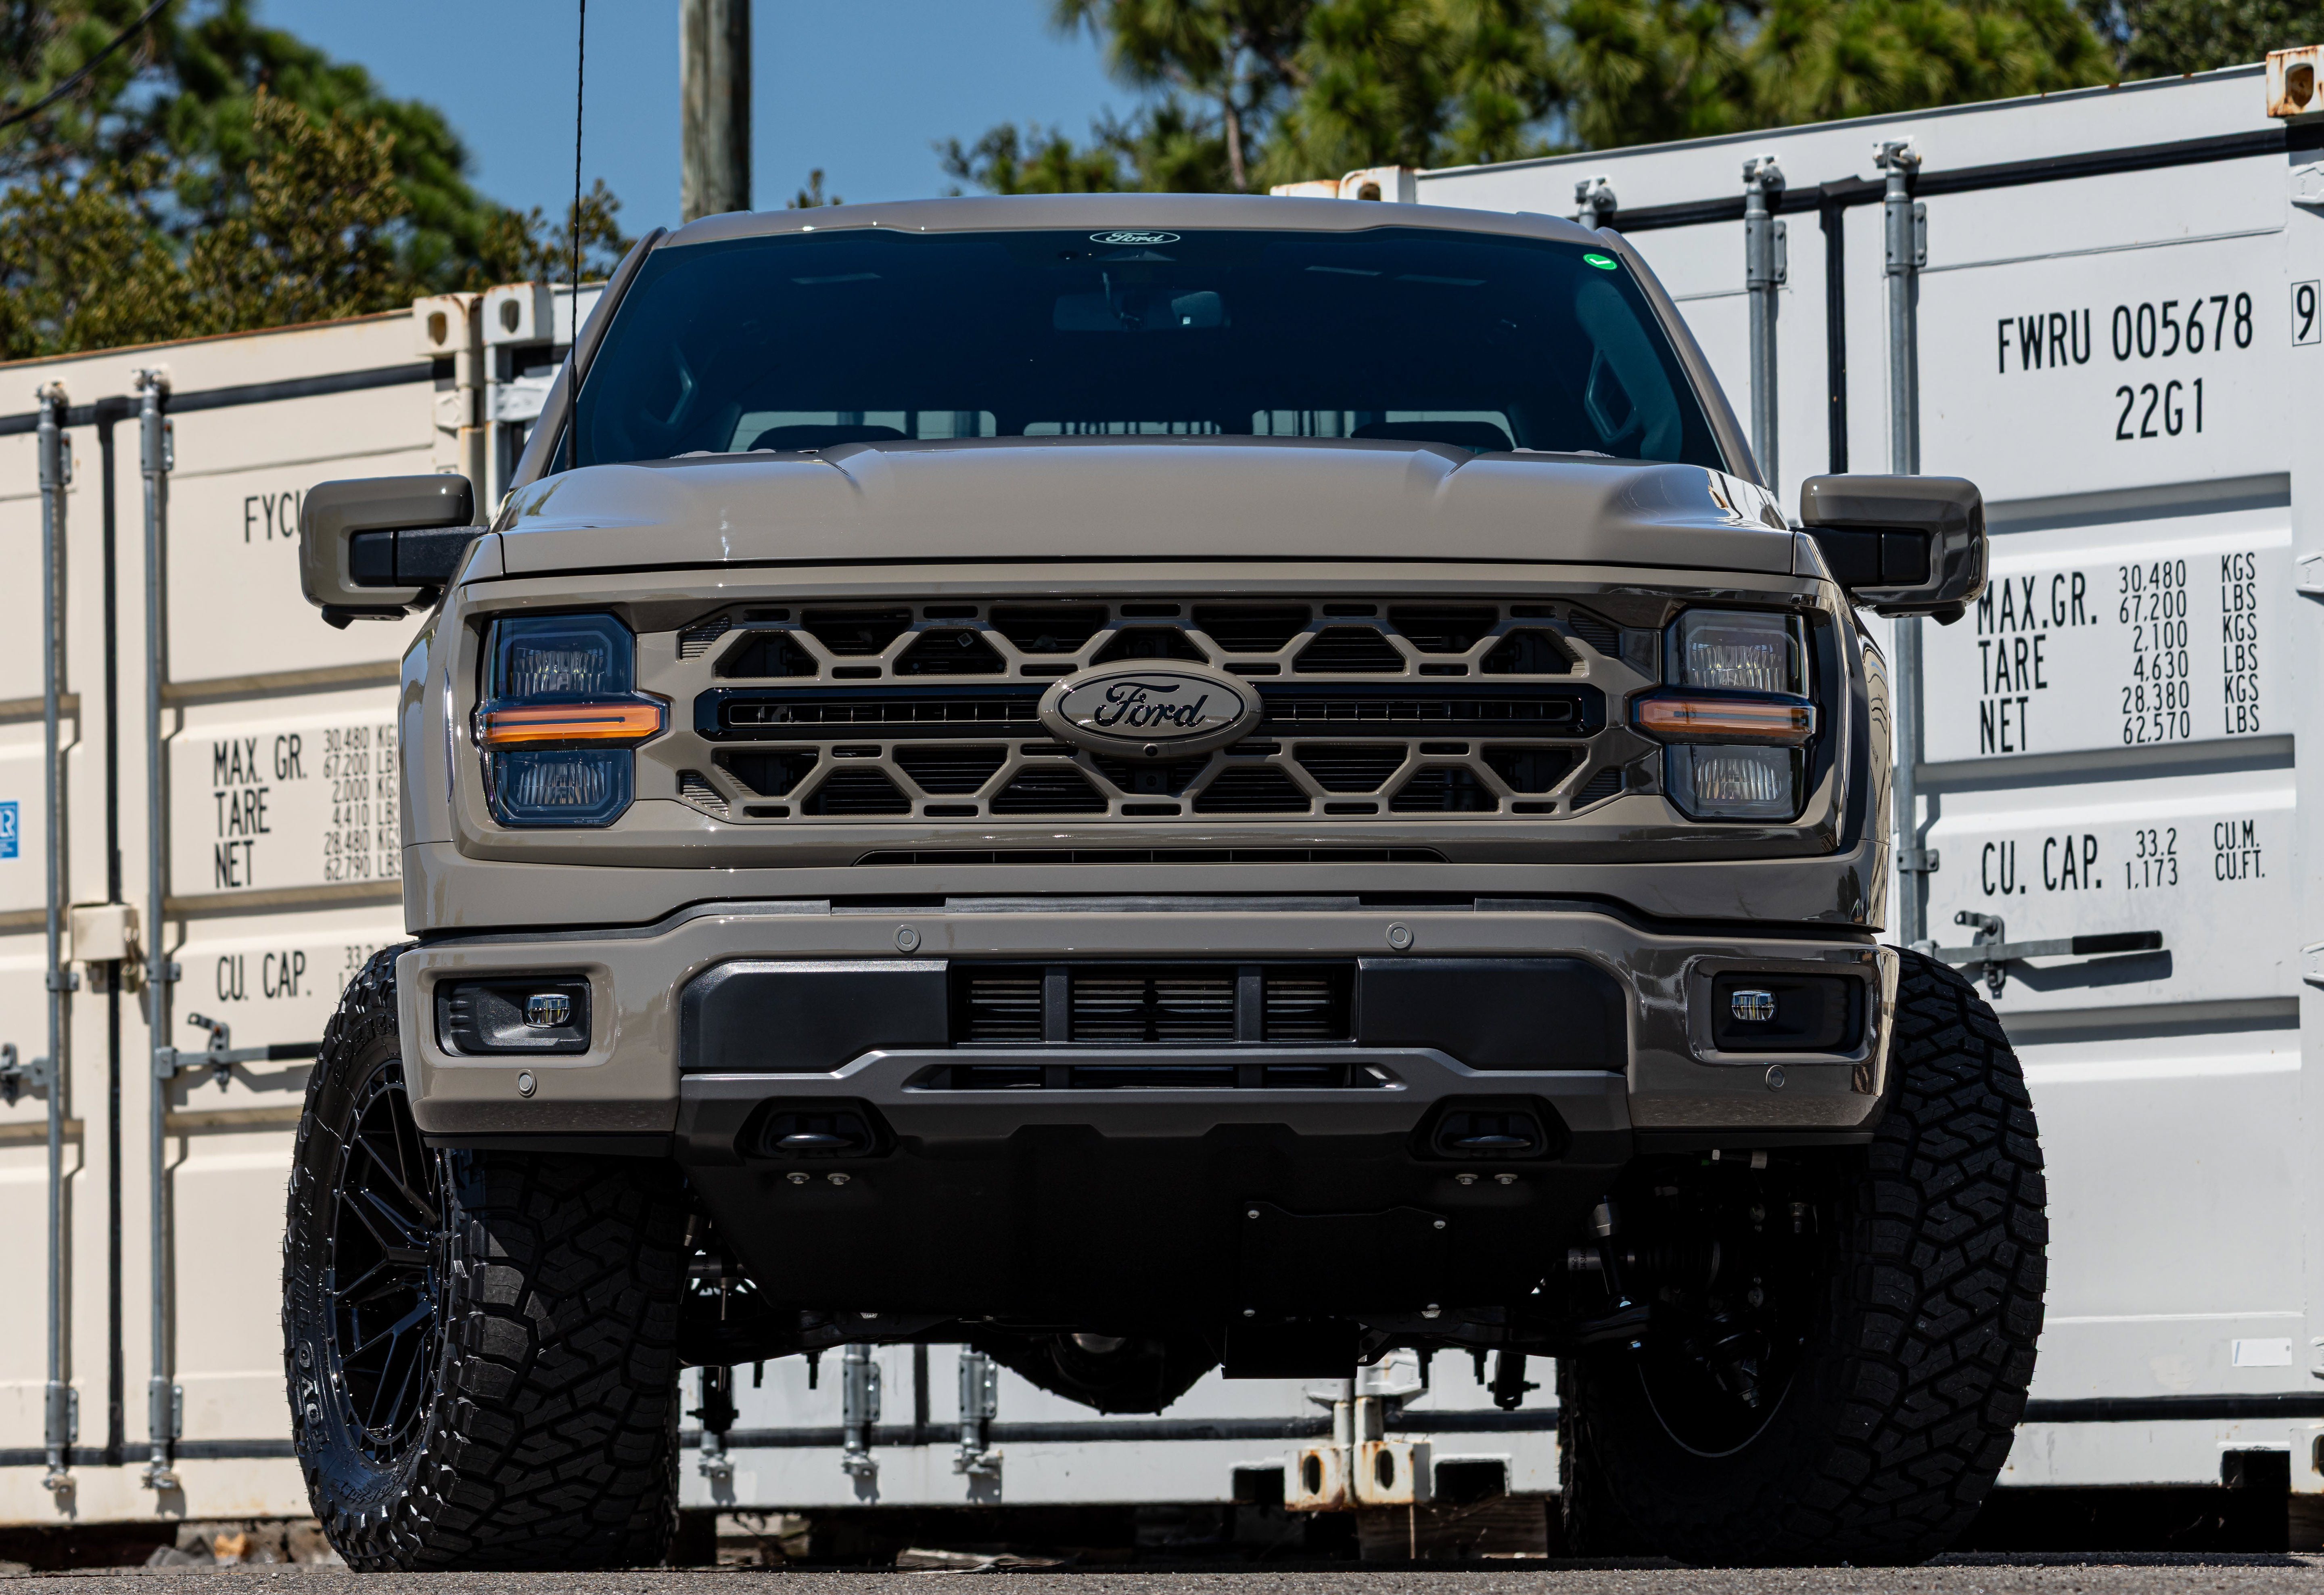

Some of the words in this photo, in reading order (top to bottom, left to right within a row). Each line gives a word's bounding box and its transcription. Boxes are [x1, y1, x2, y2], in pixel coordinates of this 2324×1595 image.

[1106, 232, 1164, 242] Ford
[1998, 308, 2090, 374] FWRU
[2112, 292, 2253, 361] 005678
[2297, 284, 2316, 341] 9
[2116, 377, 2203, 441] 22G1
[2119, 559, 2186, 594] 30,480
[2222, 552, 2255, 583] KGS
[2119, 589, 2186, 624] 67,200
[2222, 582, 2256, 613] LBS
[2133, 620, 2187, 653] 2,100
[2223, 612, 2257, 643] KGS
[1978, 634, 2048, 695] TARE
[2134, 649, 2188, 682] 4,630
[2224, 643, 2258, 674] LBS
[1094, 682, 1208, 728] Ford
[2122, 680, 2189, 714] 28,380
[2224, 673, 2259, 704] KGS
[376, 724, 396, 748] KG
[1980, 696, 2029, 755] NET
[2123, 710, 2190, 745] 62,570
[2225, 703, 2259, 735] LBS
[213, 738, 262, 787] MAX.
[274, 733, 307, 781] GR.
[376, 749, 396, 774] LB
[376, 775, 397, 800] KG
[213, 787, 271, 837] TARE
[2136, 827, 2177, 858] 33.2
[2214, 819, 2259, 851] CU.M.
[215, 839, 255, 889] NET
[1982, 840, 2026, 896] CU.
[2043, 834, 2102, 892] CAP.
[2125, 857, 2178, 890] 1,173
[2215, 849, 2265, 881] CU.FT.
[217, 955, 248, 1003] CU.
[263, 950, 311, 999] CAP.
[298, 1338, 330, 1454] TOYO
